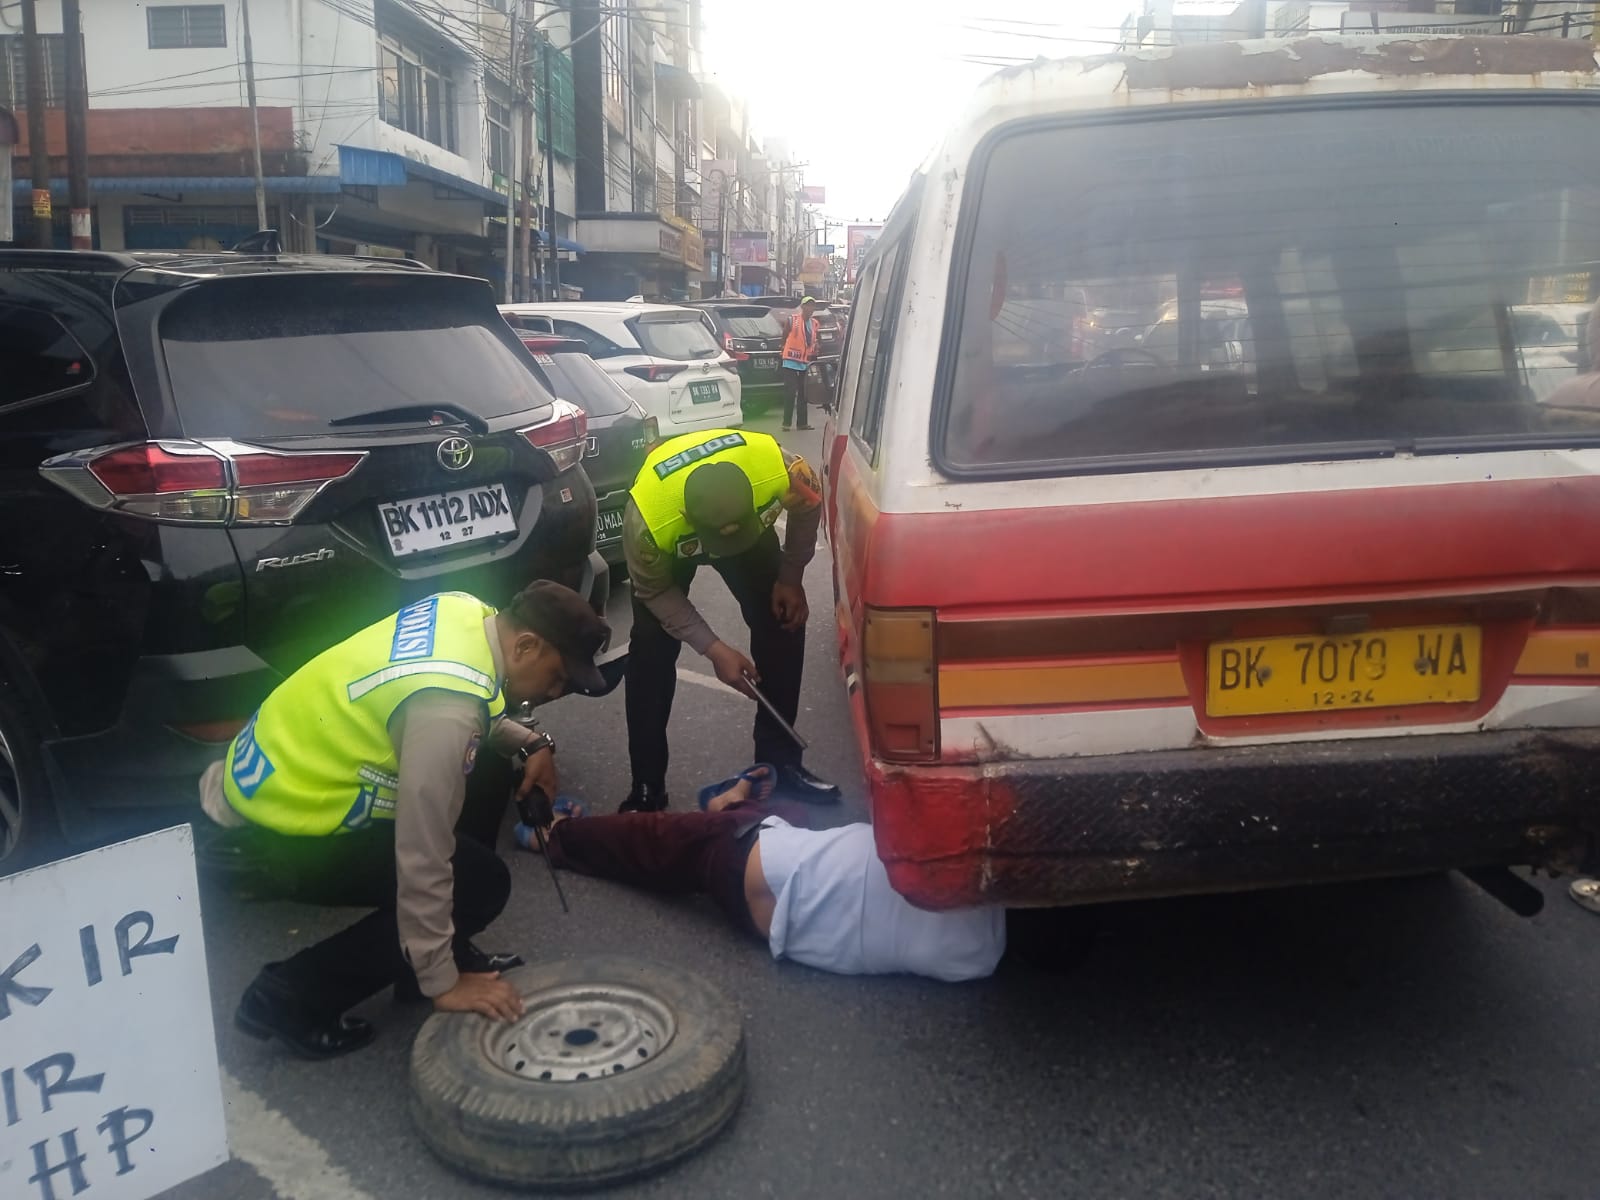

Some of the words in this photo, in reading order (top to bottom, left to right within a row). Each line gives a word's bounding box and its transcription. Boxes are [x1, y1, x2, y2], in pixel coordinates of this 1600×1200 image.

[656, 432, 745, 476] POLISI
[383, 504, 420, 537] BK
[417, 496, 468, 529] 1112
[468, 489, 509, 521] ADX
[440, 531, 452, 541] 12
[462, 526, 474, 536] 27
[604, 511, 624, 529] MAA
[256, 547, 336, 572] Rush
[1219, 646, 1271, 690] BK
[1415, 632, 1467, 676] WA
[28, 1105, 154, 1200] HP
